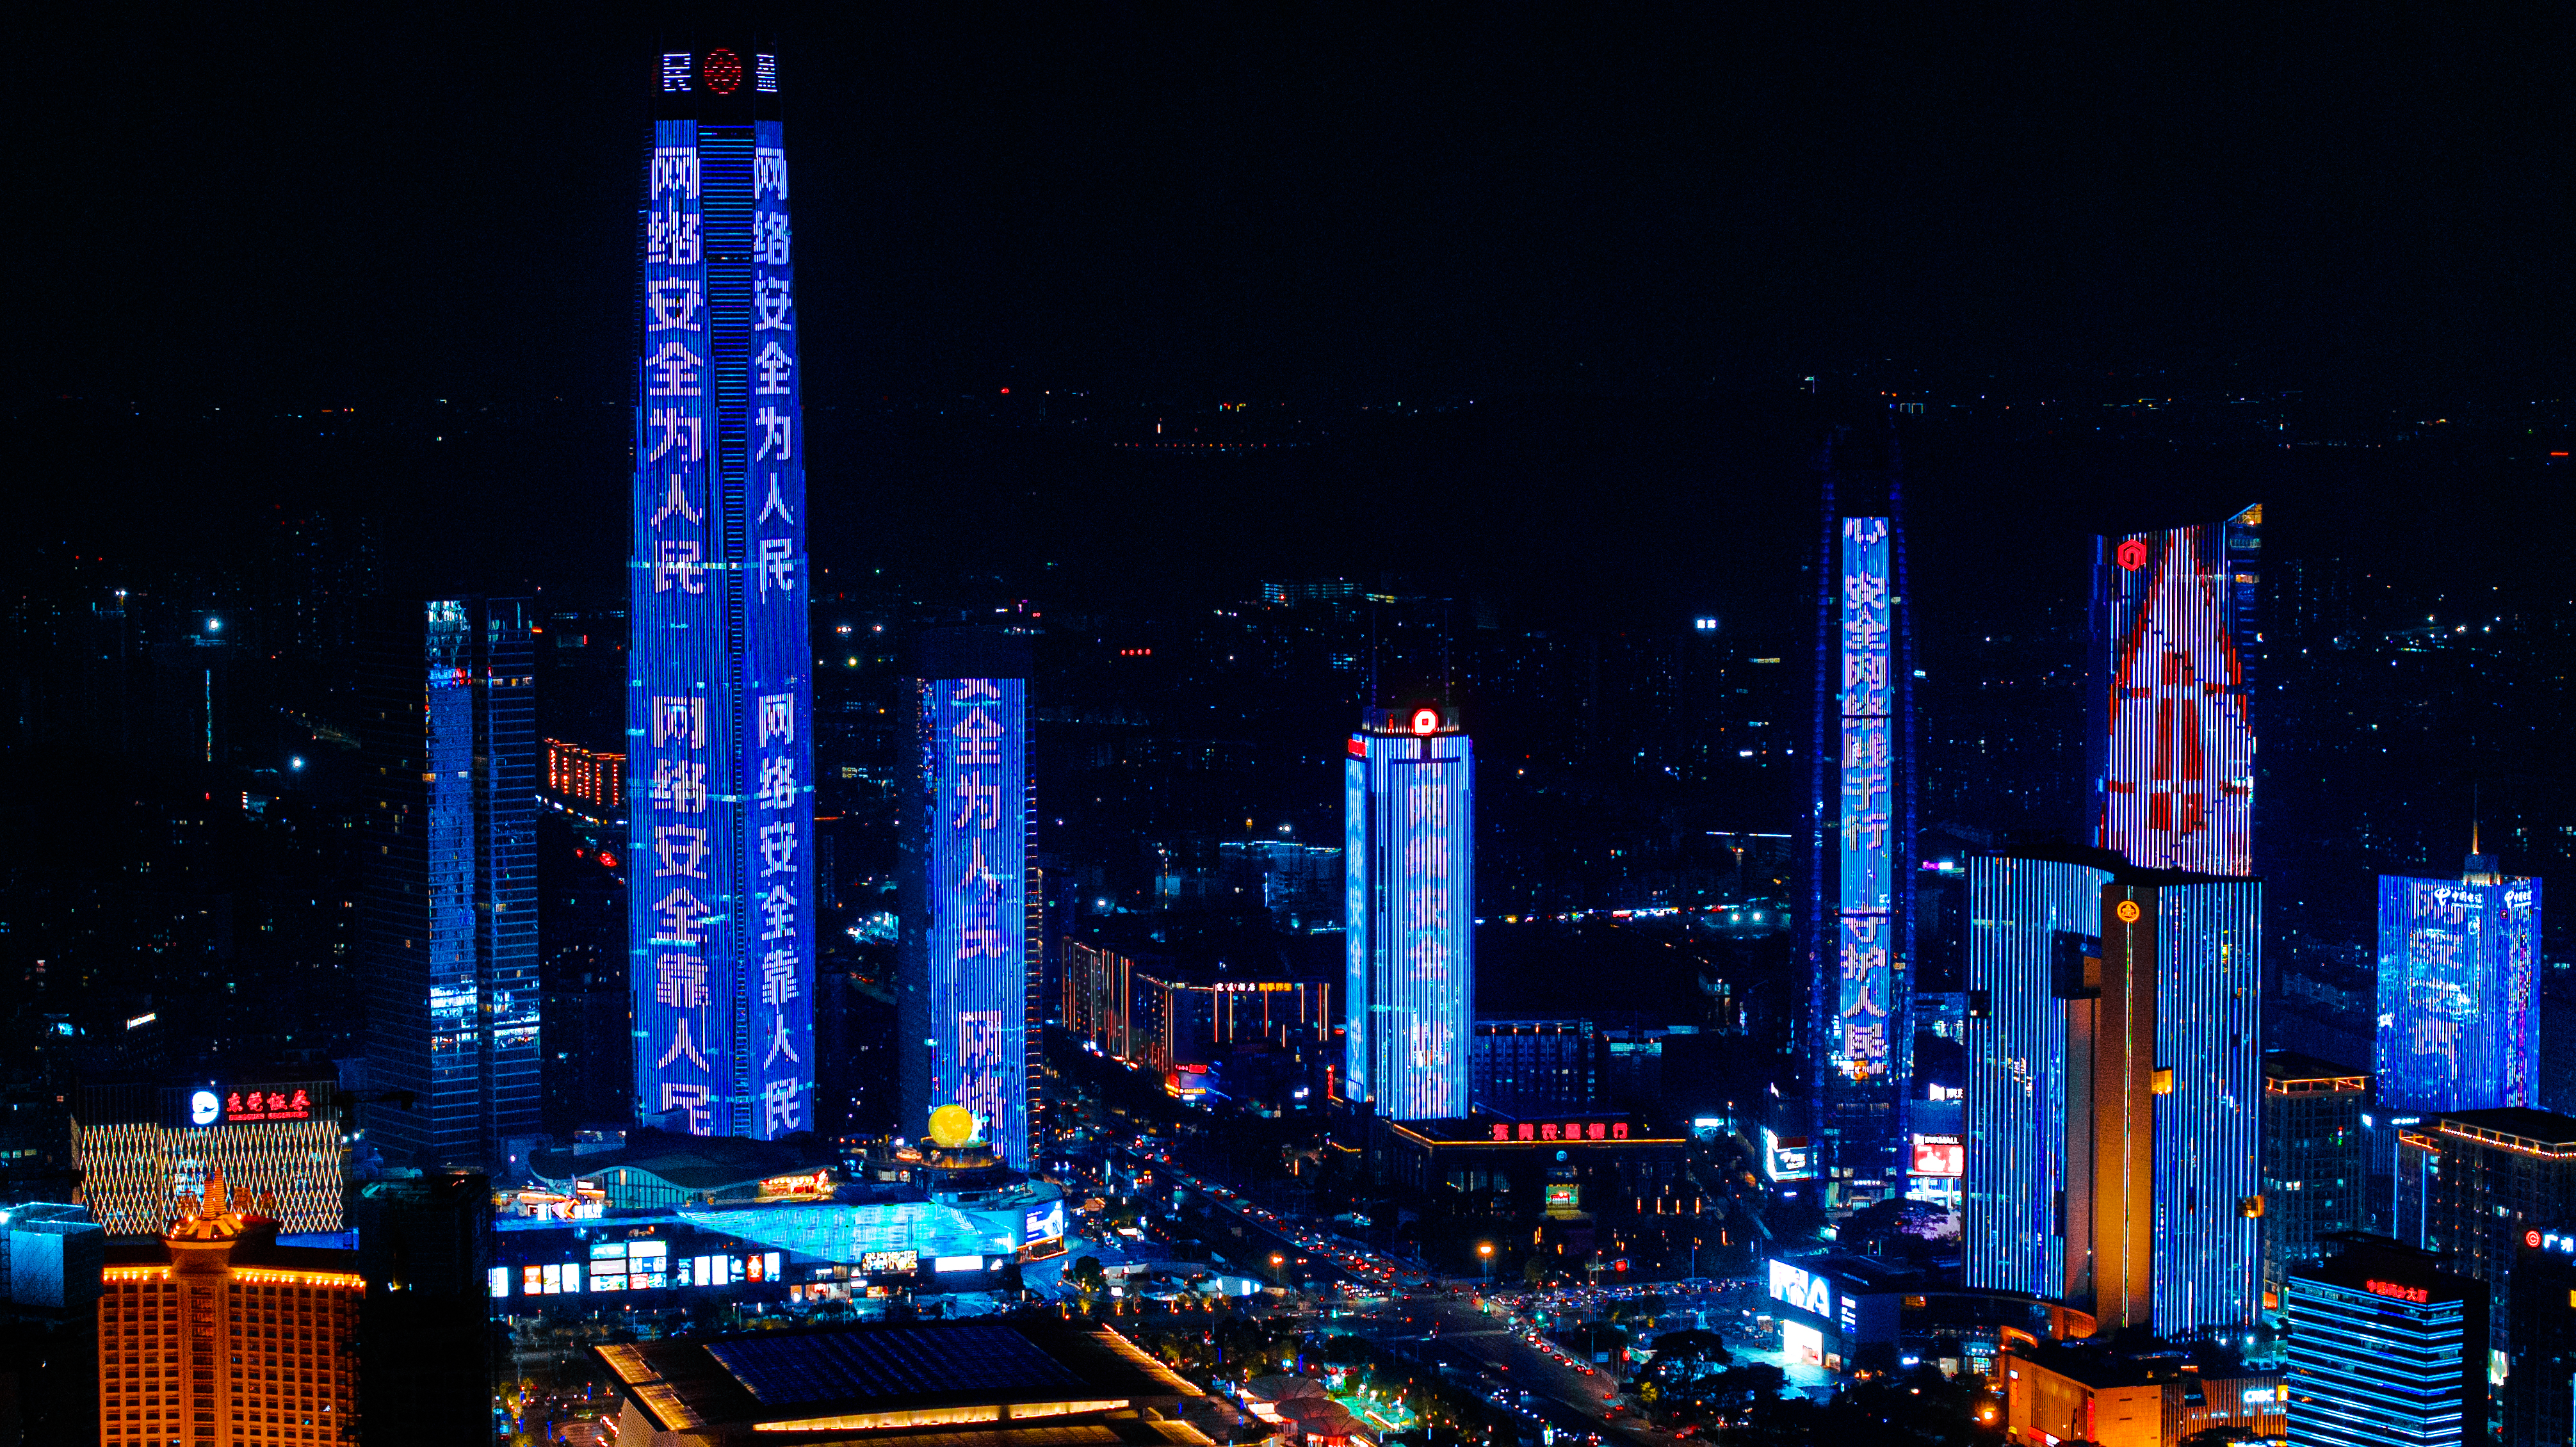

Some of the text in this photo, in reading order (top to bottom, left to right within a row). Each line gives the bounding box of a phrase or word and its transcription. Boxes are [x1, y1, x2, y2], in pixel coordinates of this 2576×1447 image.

[647, 147, 704, 594] 网络安全为人民
[753, 147, 794, 604] 网络安全为人民
[227, 1089, 311, 1113] 东莞证券
[652, 695, 711, 1136] 网络安全靠人民
[759, 692, 800, 1141] 网络安全靠人民
